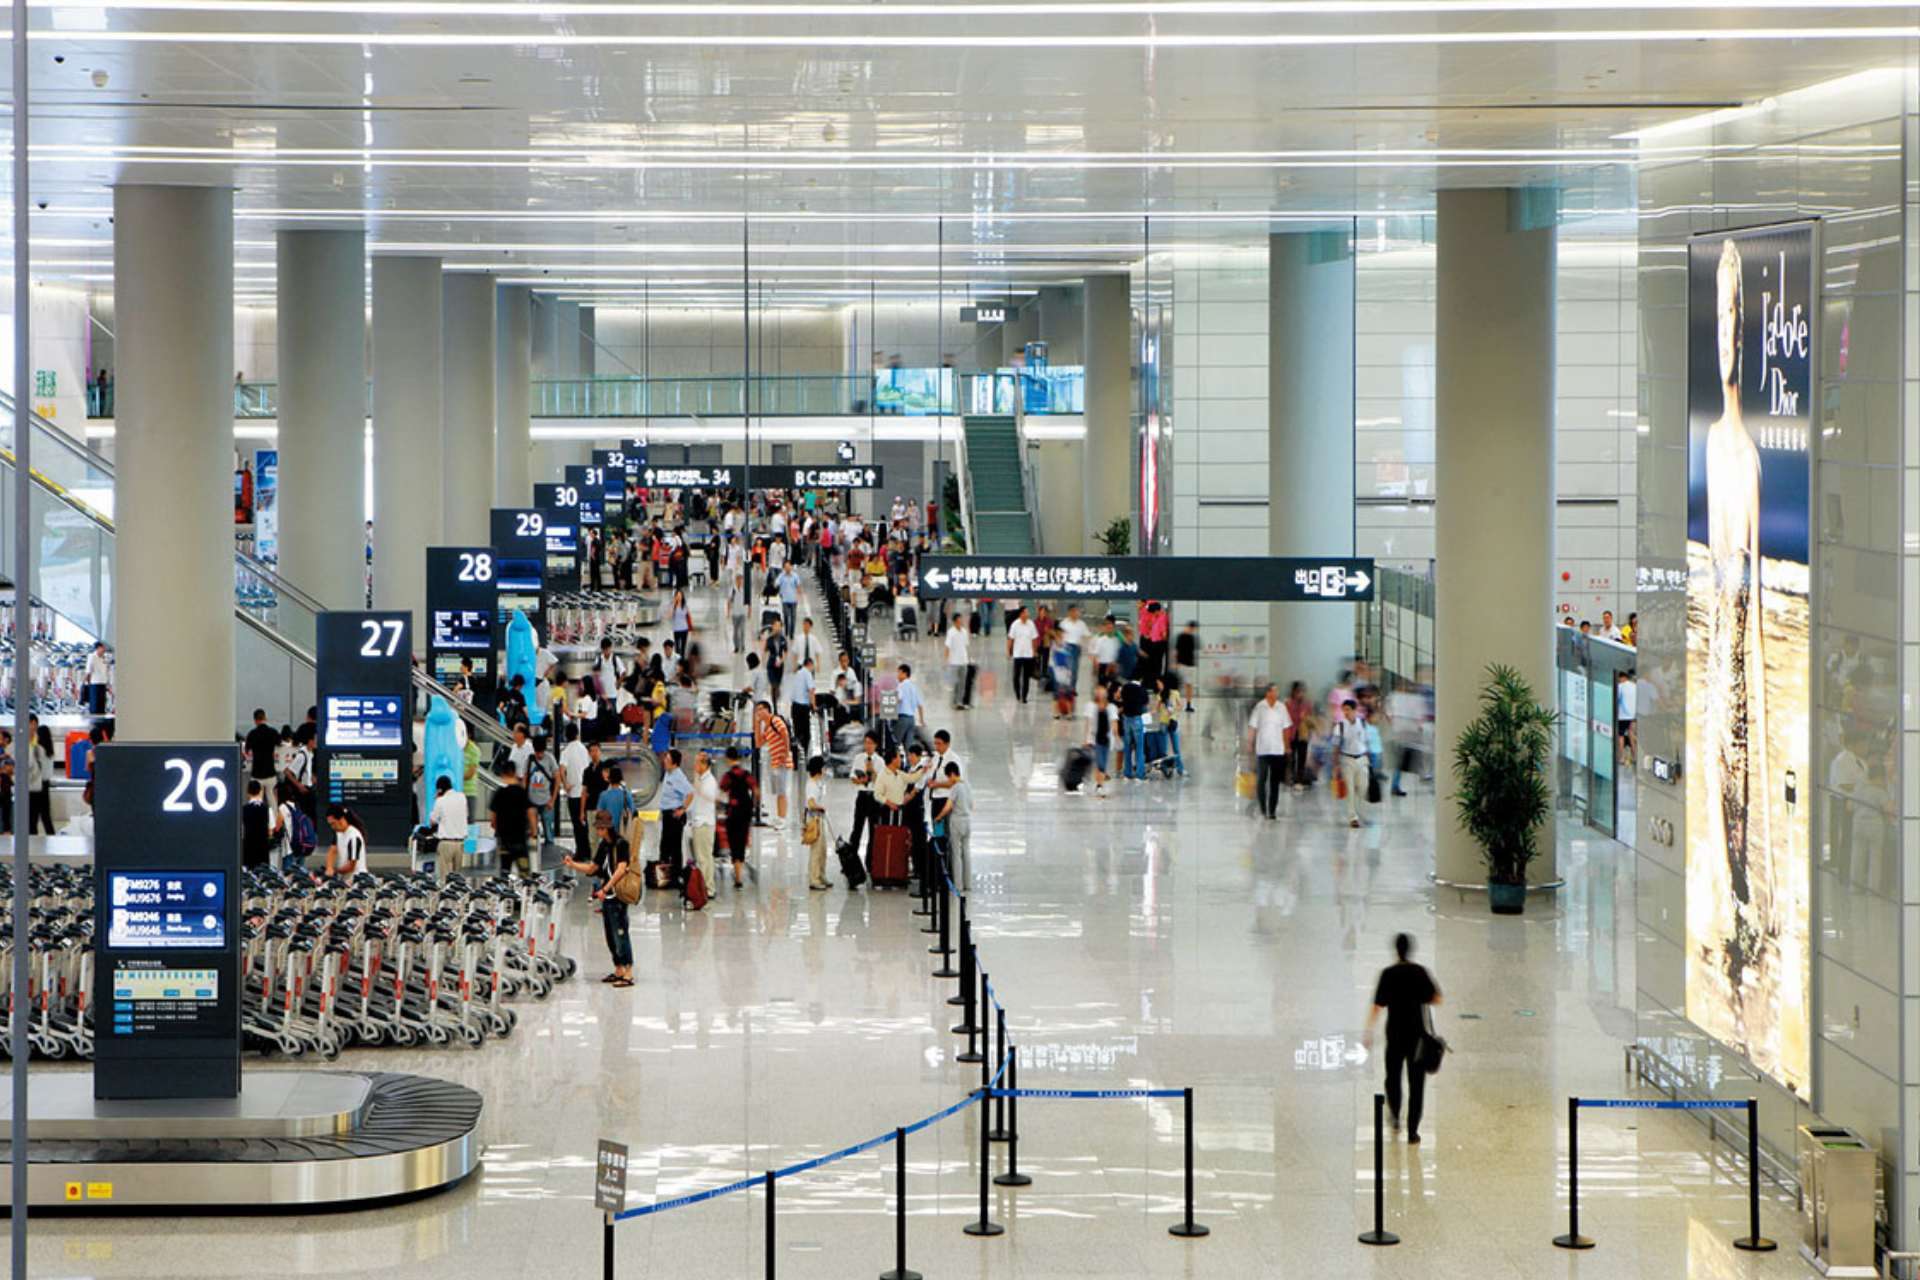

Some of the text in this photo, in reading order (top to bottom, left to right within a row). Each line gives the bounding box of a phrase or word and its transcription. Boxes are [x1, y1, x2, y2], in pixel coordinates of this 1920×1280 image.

[1769, 367, 1799, 416] Dior
[607, 451, 625, 468] 32
[585, 467, 604, 486] 31
[712, 469, 731, 486] 34
[795, 470, 806, 487] B
[806, 470, 818, 487] C
[554, 486, 578, 507] 30
[515, 512, 543, 537] 29
[458, 553, 492, 582] 28
[1294, 569, 1320, 585] 出口
[952, 582, 983, 592] Transfer
[1030, 583, 1062, 592] Counter
[360, 619, 403, 657] 27
[163, 758, 228, 812] 26
